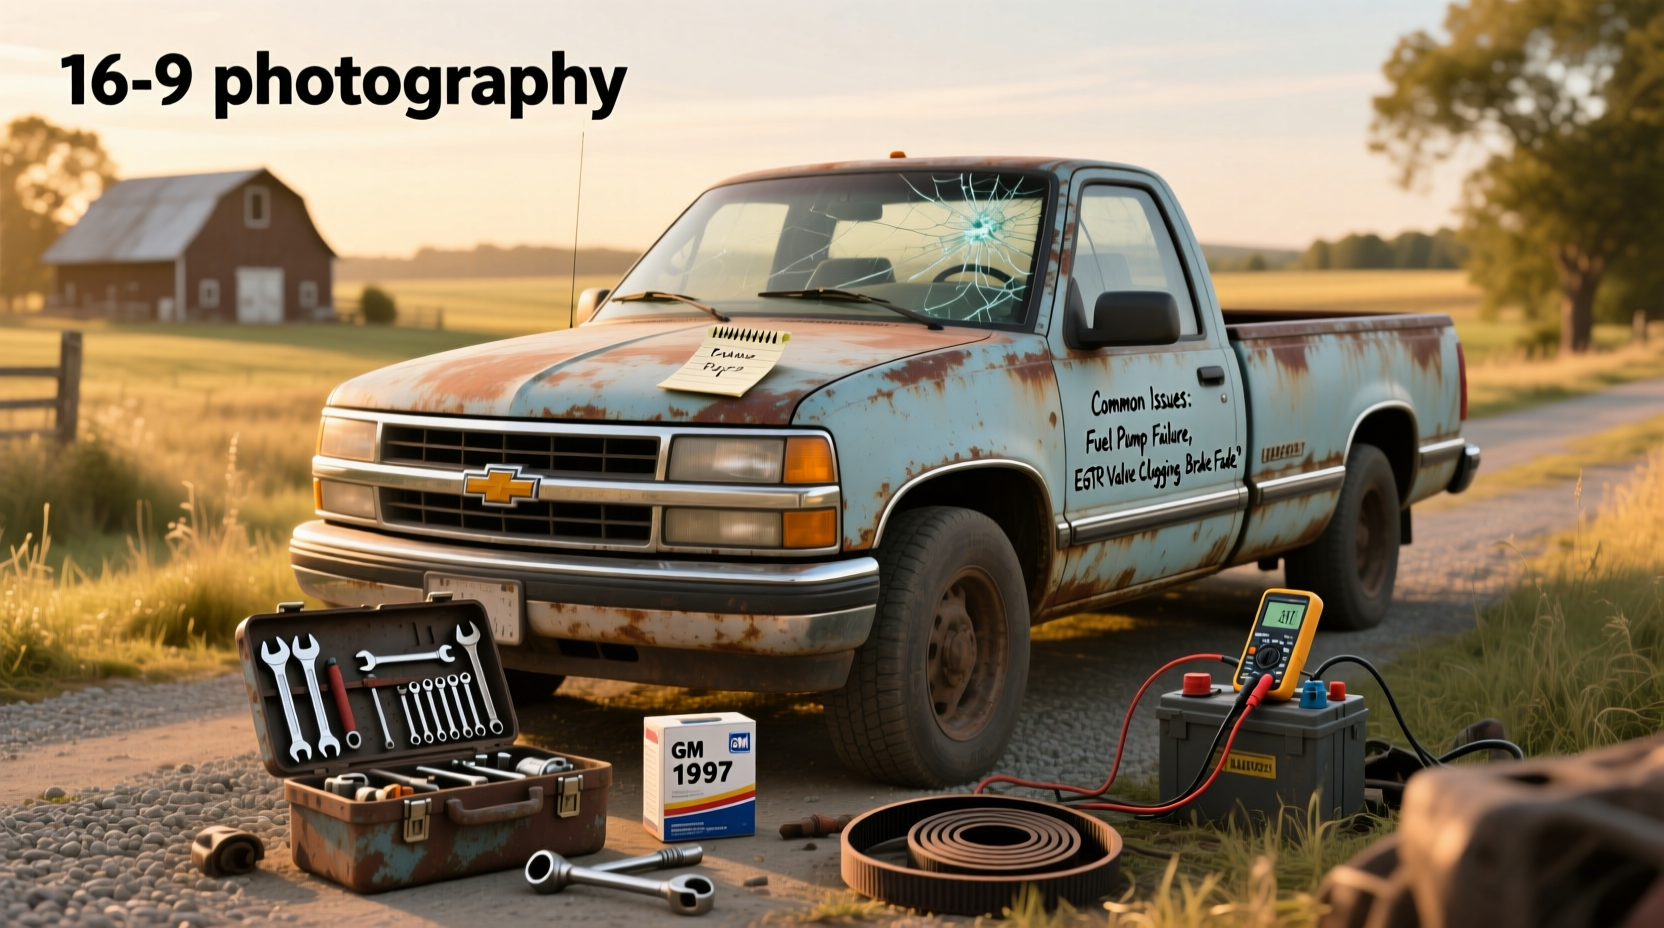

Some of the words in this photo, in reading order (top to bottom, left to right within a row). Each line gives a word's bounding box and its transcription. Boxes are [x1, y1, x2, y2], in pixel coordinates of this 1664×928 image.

[1091, 390, 1145, 416] Common
[1150, 386, 1192, 410] Issues:
[1086, 427, 1112, 454] Fuel
[1117, 425, 1147, 456] Pump
[1152, 421, 1192, 446] Failure,
[671, 741, 704, 759] GM
[673, 761, 733, 785] 1997
